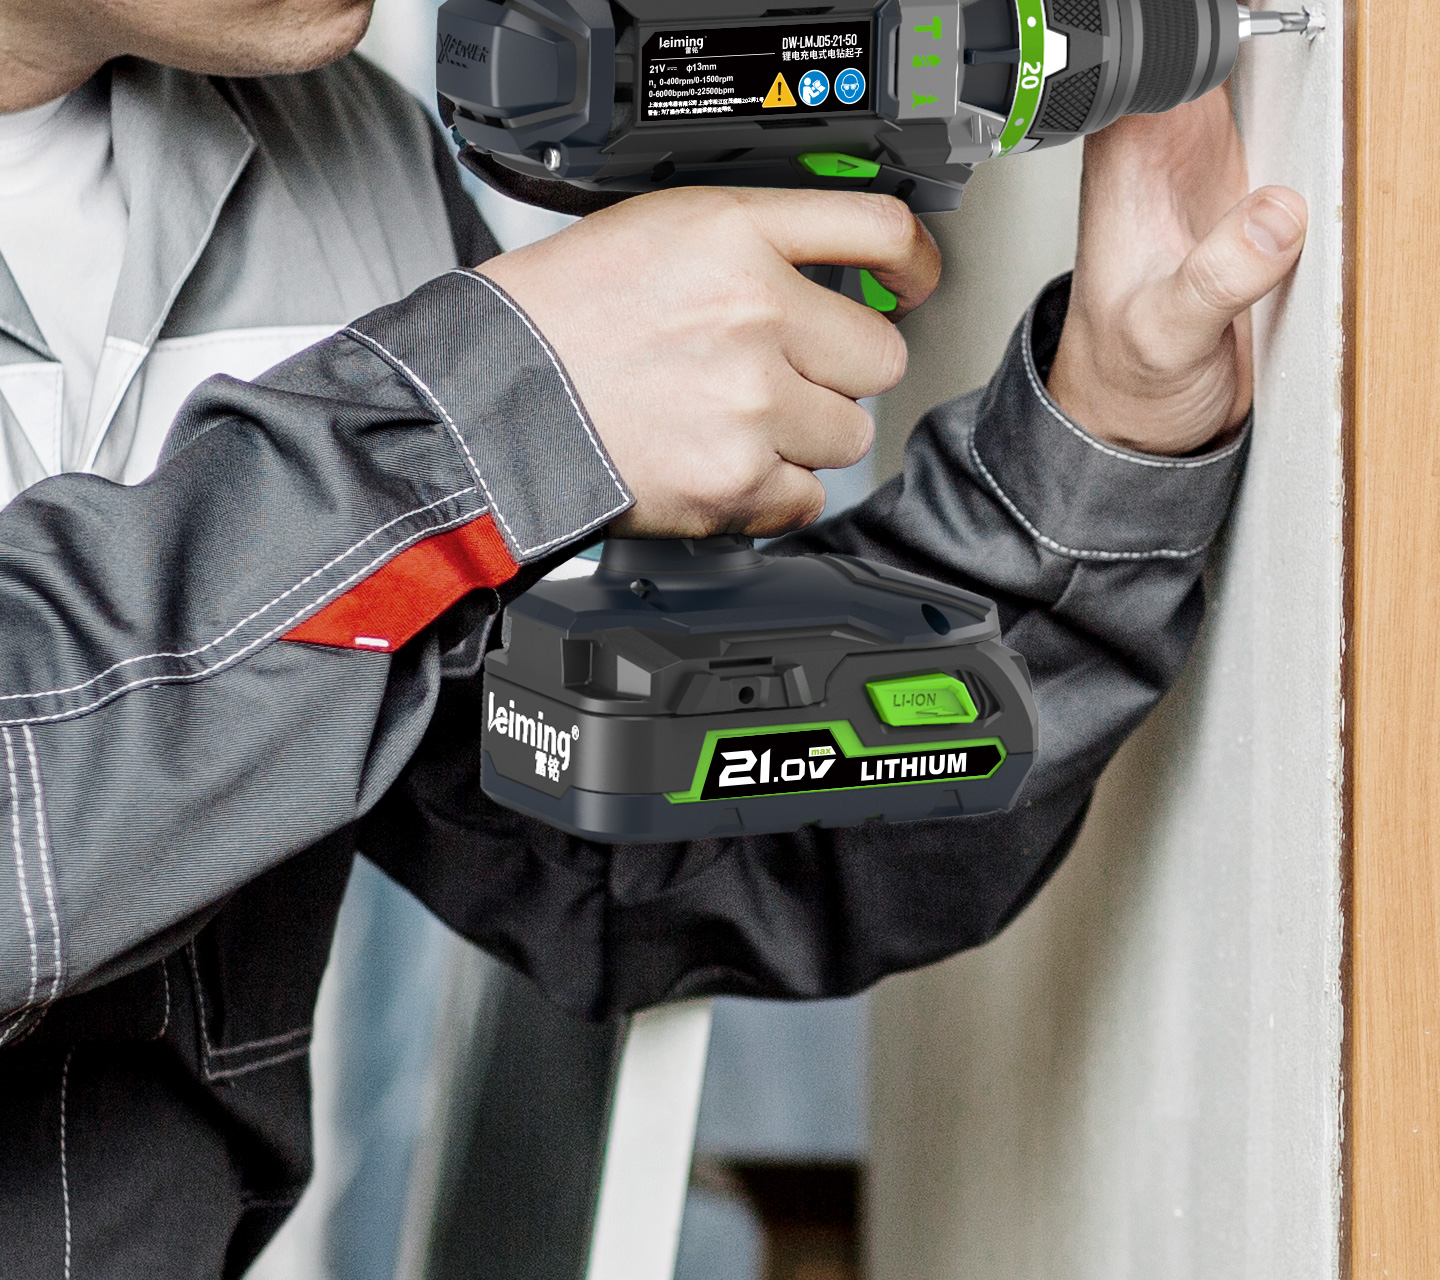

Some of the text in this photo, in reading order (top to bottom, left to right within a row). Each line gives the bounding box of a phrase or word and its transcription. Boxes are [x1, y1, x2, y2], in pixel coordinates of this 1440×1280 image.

[781, 47, 864, 62] 锂电充电式电钻起子
[1020, 61, 1042, 90] 20
[892, 692, 937, 708] LI-ION
[810, 746, 833, 757] max
[860, 752, 968, 782] LITHIUM
